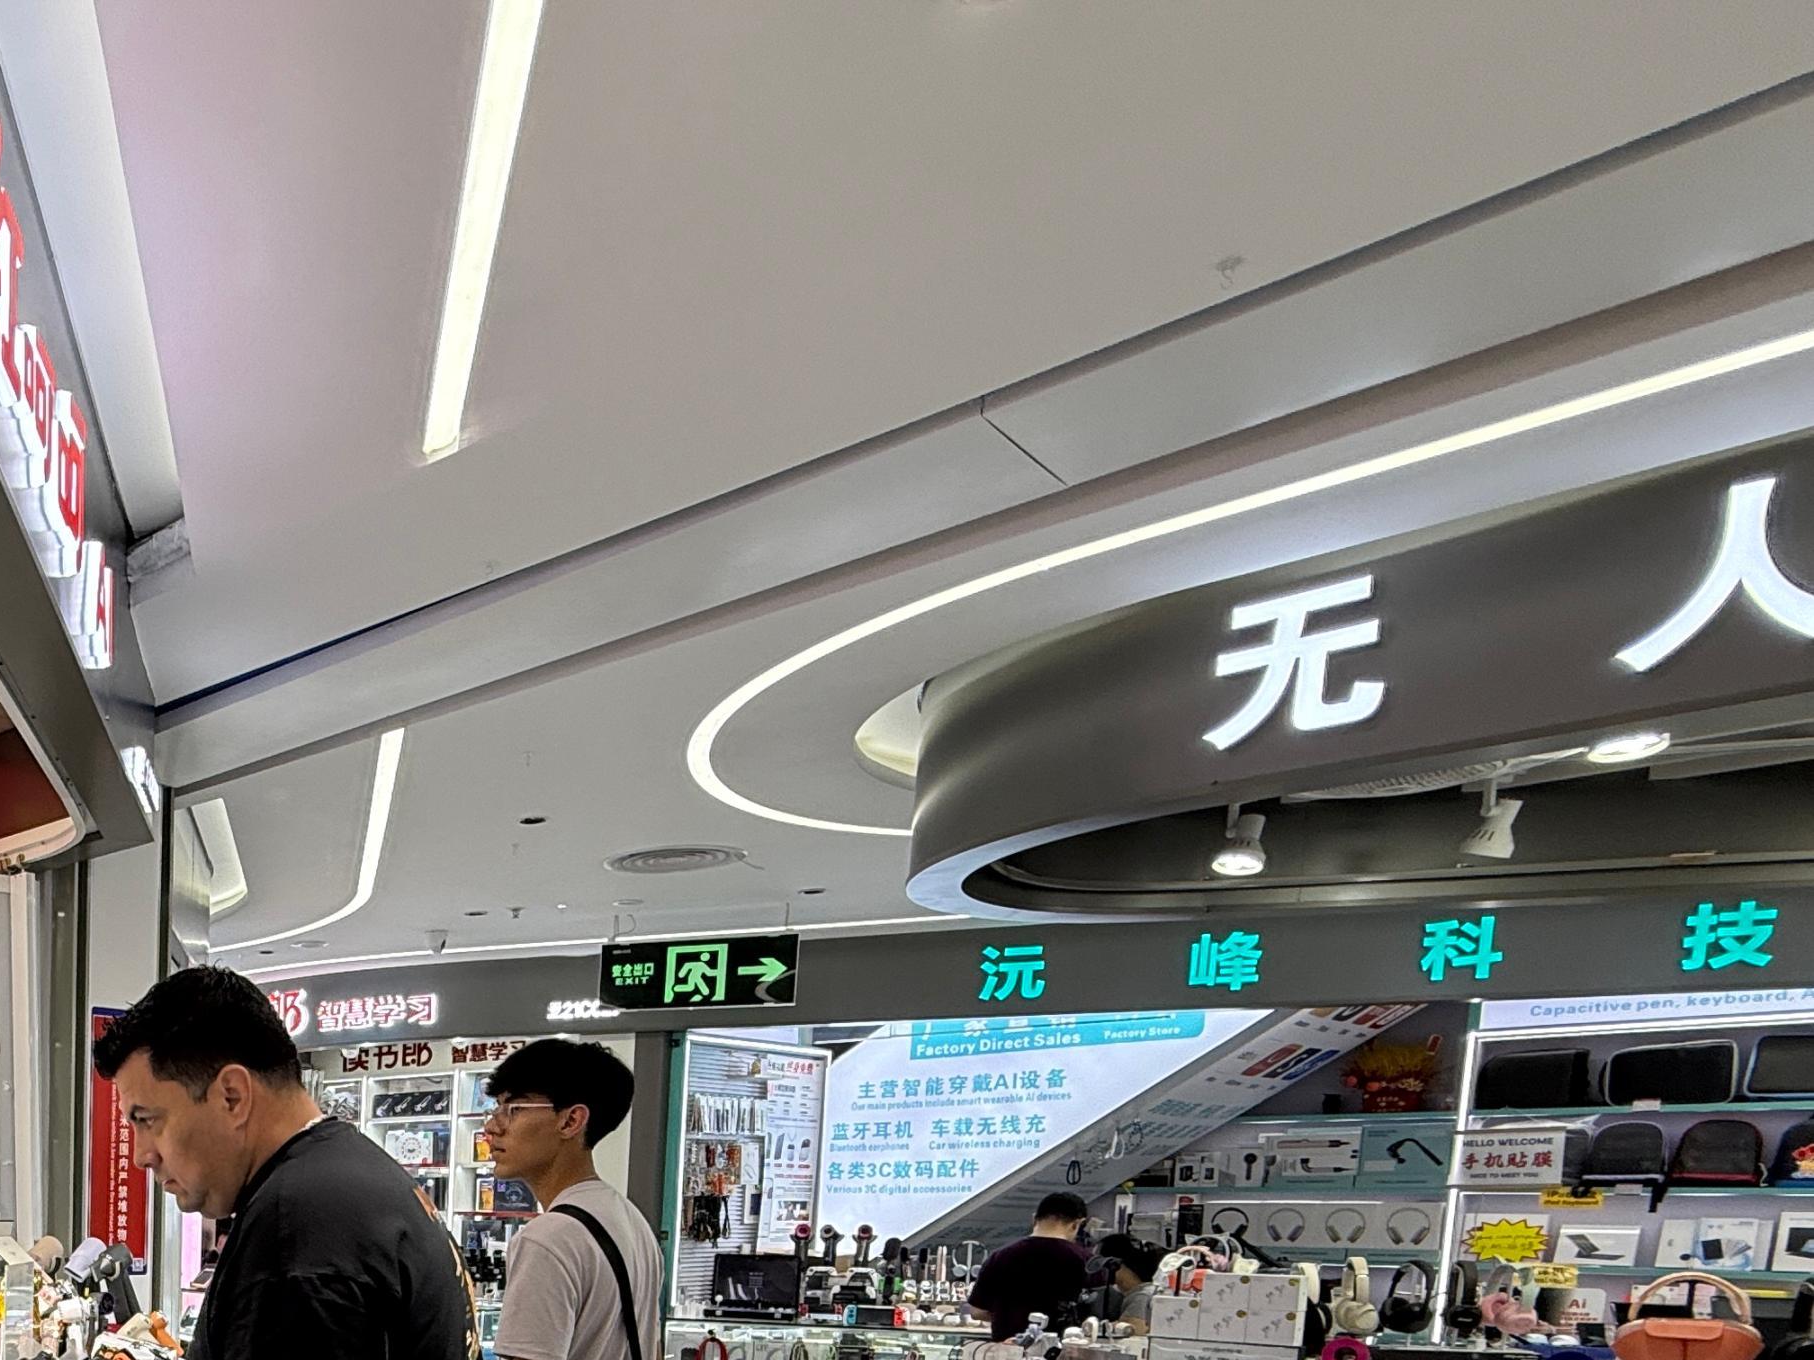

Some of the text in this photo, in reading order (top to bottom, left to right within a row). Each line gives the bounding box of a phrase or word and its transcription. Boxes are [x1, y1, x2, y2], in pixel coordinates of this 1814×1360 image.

[1203, 478, 1814, 750] 无人
[979, 899, 1779, 1002] 沅峰科技
[611, 962, 655, 977] 安全出口
[614, 976, 650, 986] EXIT
[316, 992, 439, 1034] 智慧学习
[1529, 1000, 1632, 1018] Capacitive
[1635, 997, 1681, 1013] pen,
[1685, 990, 1794, 1008] keyboard,
[916, 1032, 1082, 1058] Factory Direct Sales
[1103, 1026, 1181, 1041] Factory Store
[340, 1041, 434, 1073] 读书郎
[857, 1067, 1068, 1101] 主营智能穿戴AI设备
[851, 1102, 866, 1112] Our
[867, 1101, 887, 1111] main
[887, 1099, 924, 1112] products
[924, 1097, 955, 1109] include
[955, 1095, 982, 1107] smart
[982, 1093, 1024, 1106] wearable
[1036, 1090, 1072, 1102] devices
[830, 1113, 1047, 1142] 蓝牙耳机 车载无线充
[829, 1137, 1041, 1153] Bluetooth earphones Car wireless charging
[1463, 1136, 1555, 1148] HELLO WELCOME
[827, 1158, 980, 1181] 各类3C数码配件
[826, 1183, 973, 1195] Various 3C digital accessories
